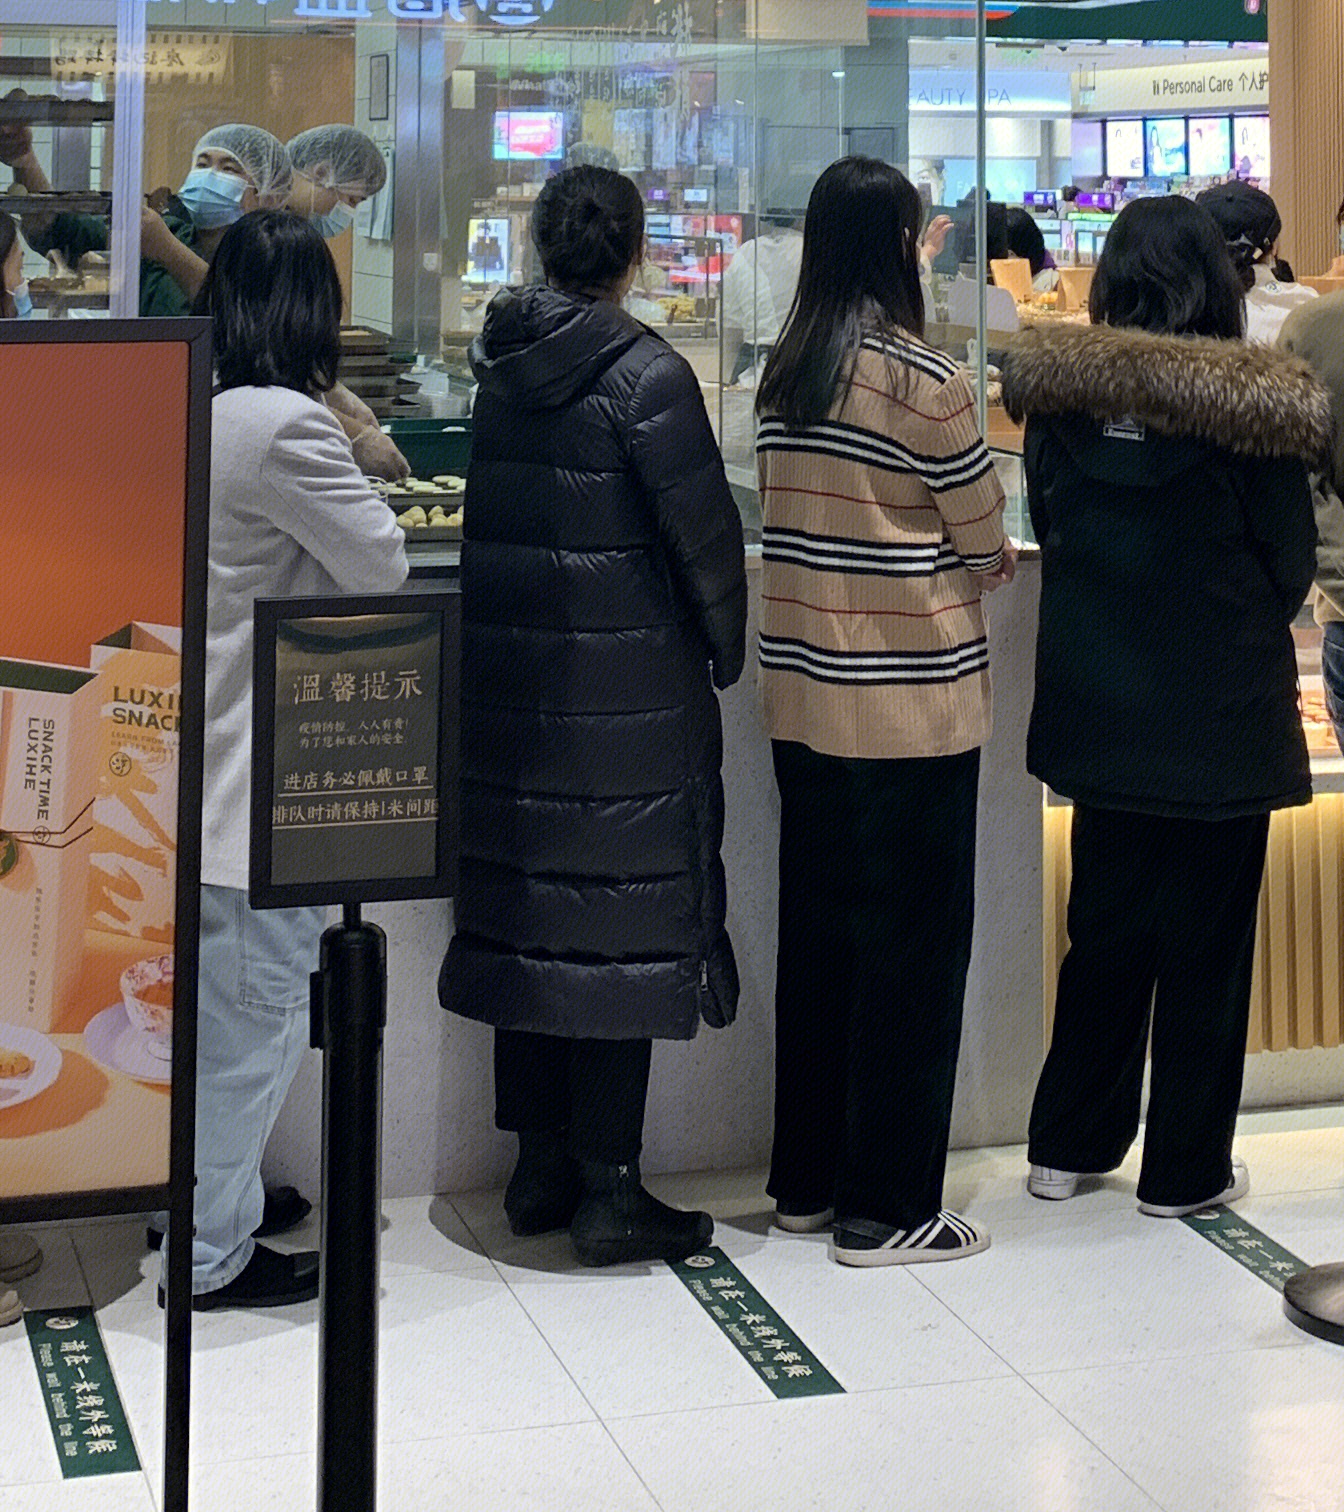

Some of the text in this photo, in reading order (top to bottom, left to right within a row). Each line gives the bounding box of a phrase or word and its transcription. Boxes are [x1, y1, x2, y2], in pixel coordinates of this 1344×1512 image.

[1162, 75, 1205, 96] Personal
[1208, 75, 1234, 93] Care
[113, 685, 181, 710] LUXI
[23, 717, 40, 792] LUXIHE
[37, 718, 55, 821] SNACK TIME
[284, 766, 429, 791] 进店务必佩戴口罩
